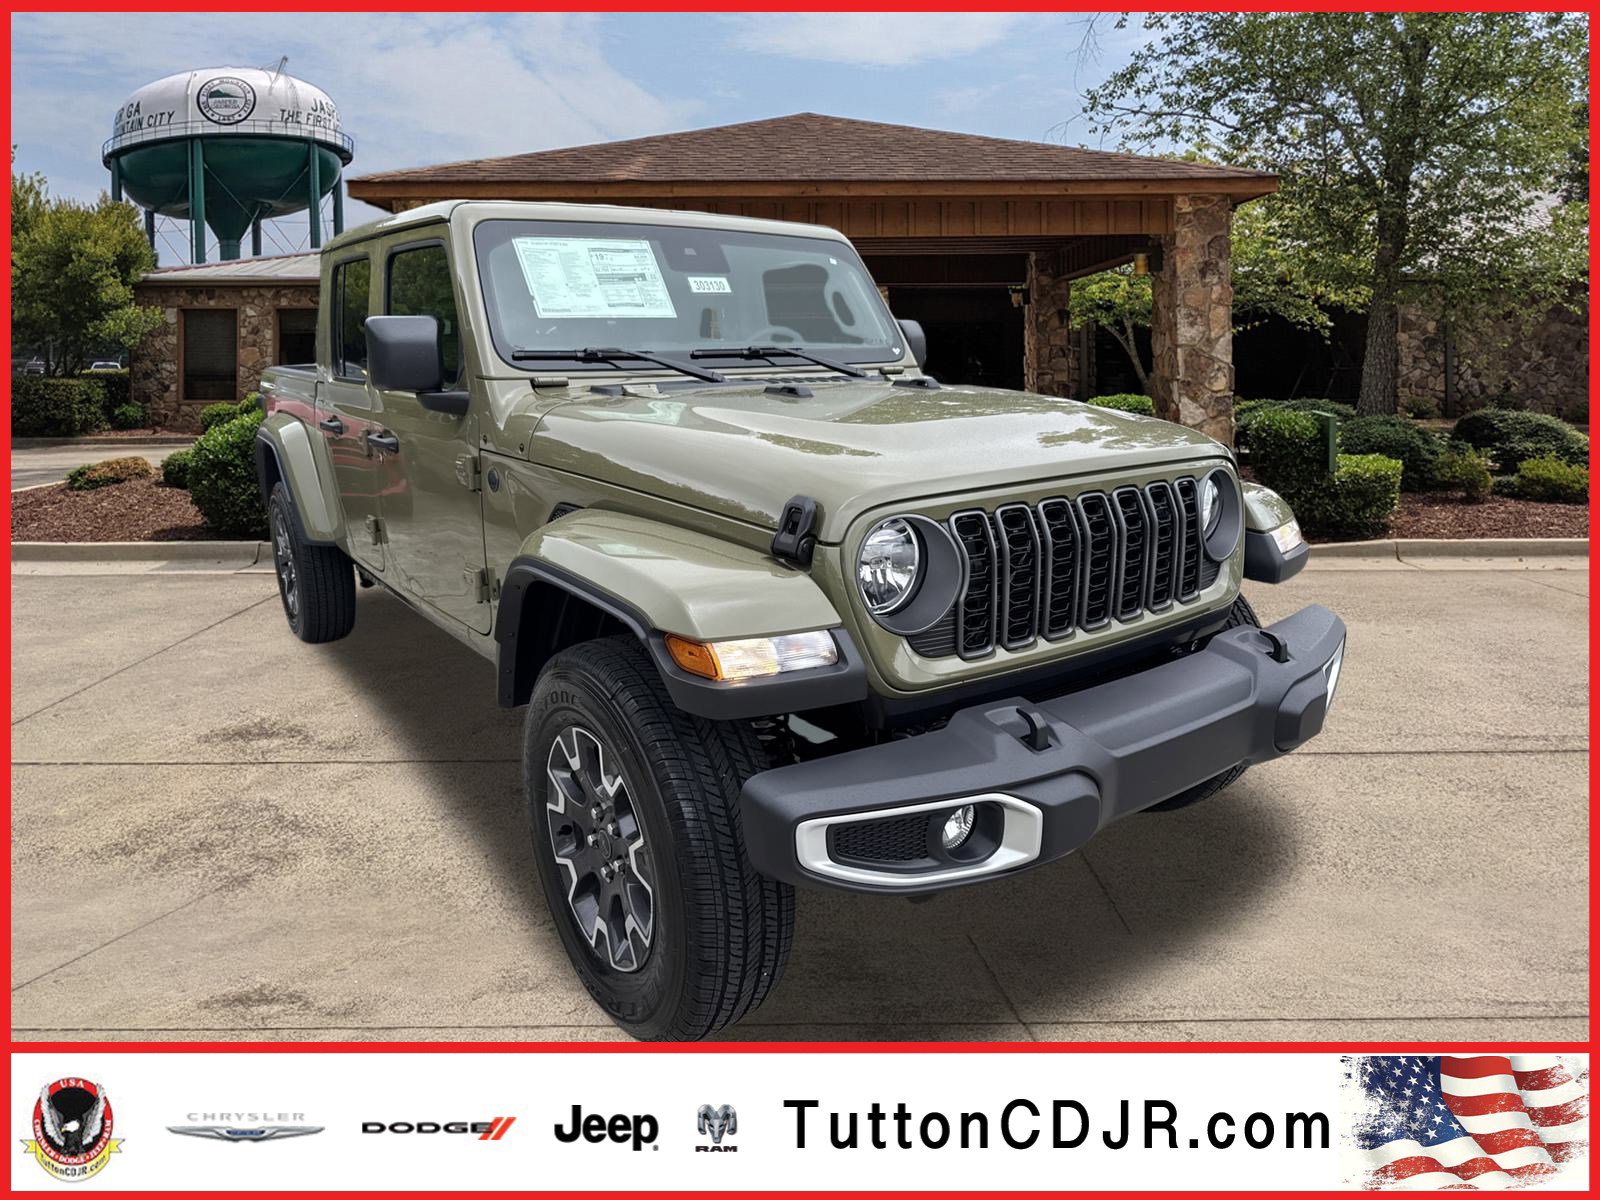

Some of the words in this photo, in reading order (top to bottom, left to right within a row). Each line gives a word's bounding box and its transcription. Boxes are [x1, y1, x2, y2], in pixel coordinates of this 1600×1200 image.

[127, 101, 141, 119] GA
[147, 110, 175, 128] CITY
[280, 109, 303, 124] THE
[306, 112, 331, 130] FIRST
